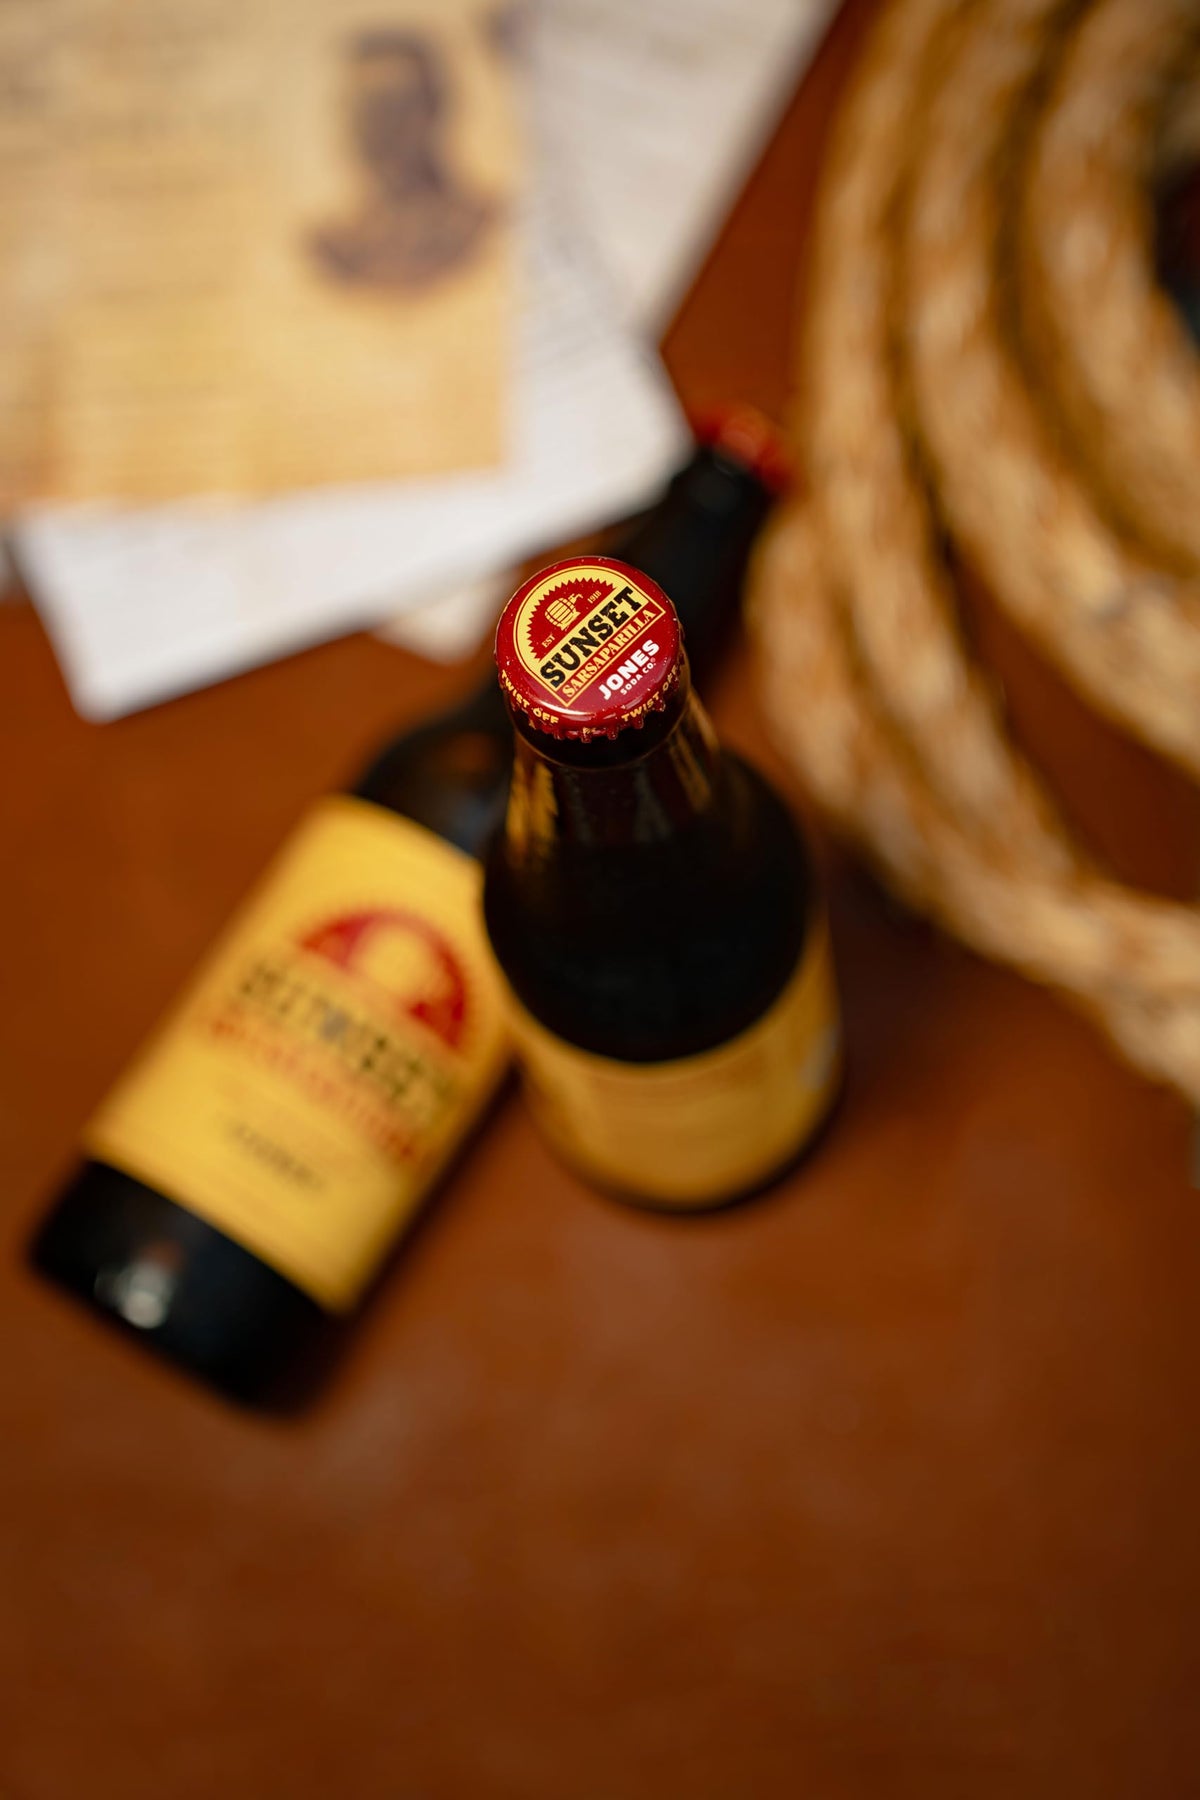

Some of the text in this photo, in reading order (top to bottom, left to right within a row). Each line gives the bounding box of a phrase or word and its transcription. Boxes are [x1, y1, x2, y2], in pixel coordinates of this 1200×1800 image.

[540, 586, 642, 688] SUNSET
[542, 590, 602, 649] EST 1918
[562, 607, 657, 698] SARSAPARILLA
[598, 640, 660, 700] JONES
[501, 669, 559, 724] TWIST OFF
[620, 673, 643, 696] SODA
[621, 664, 678, 722] TWIST OFF
